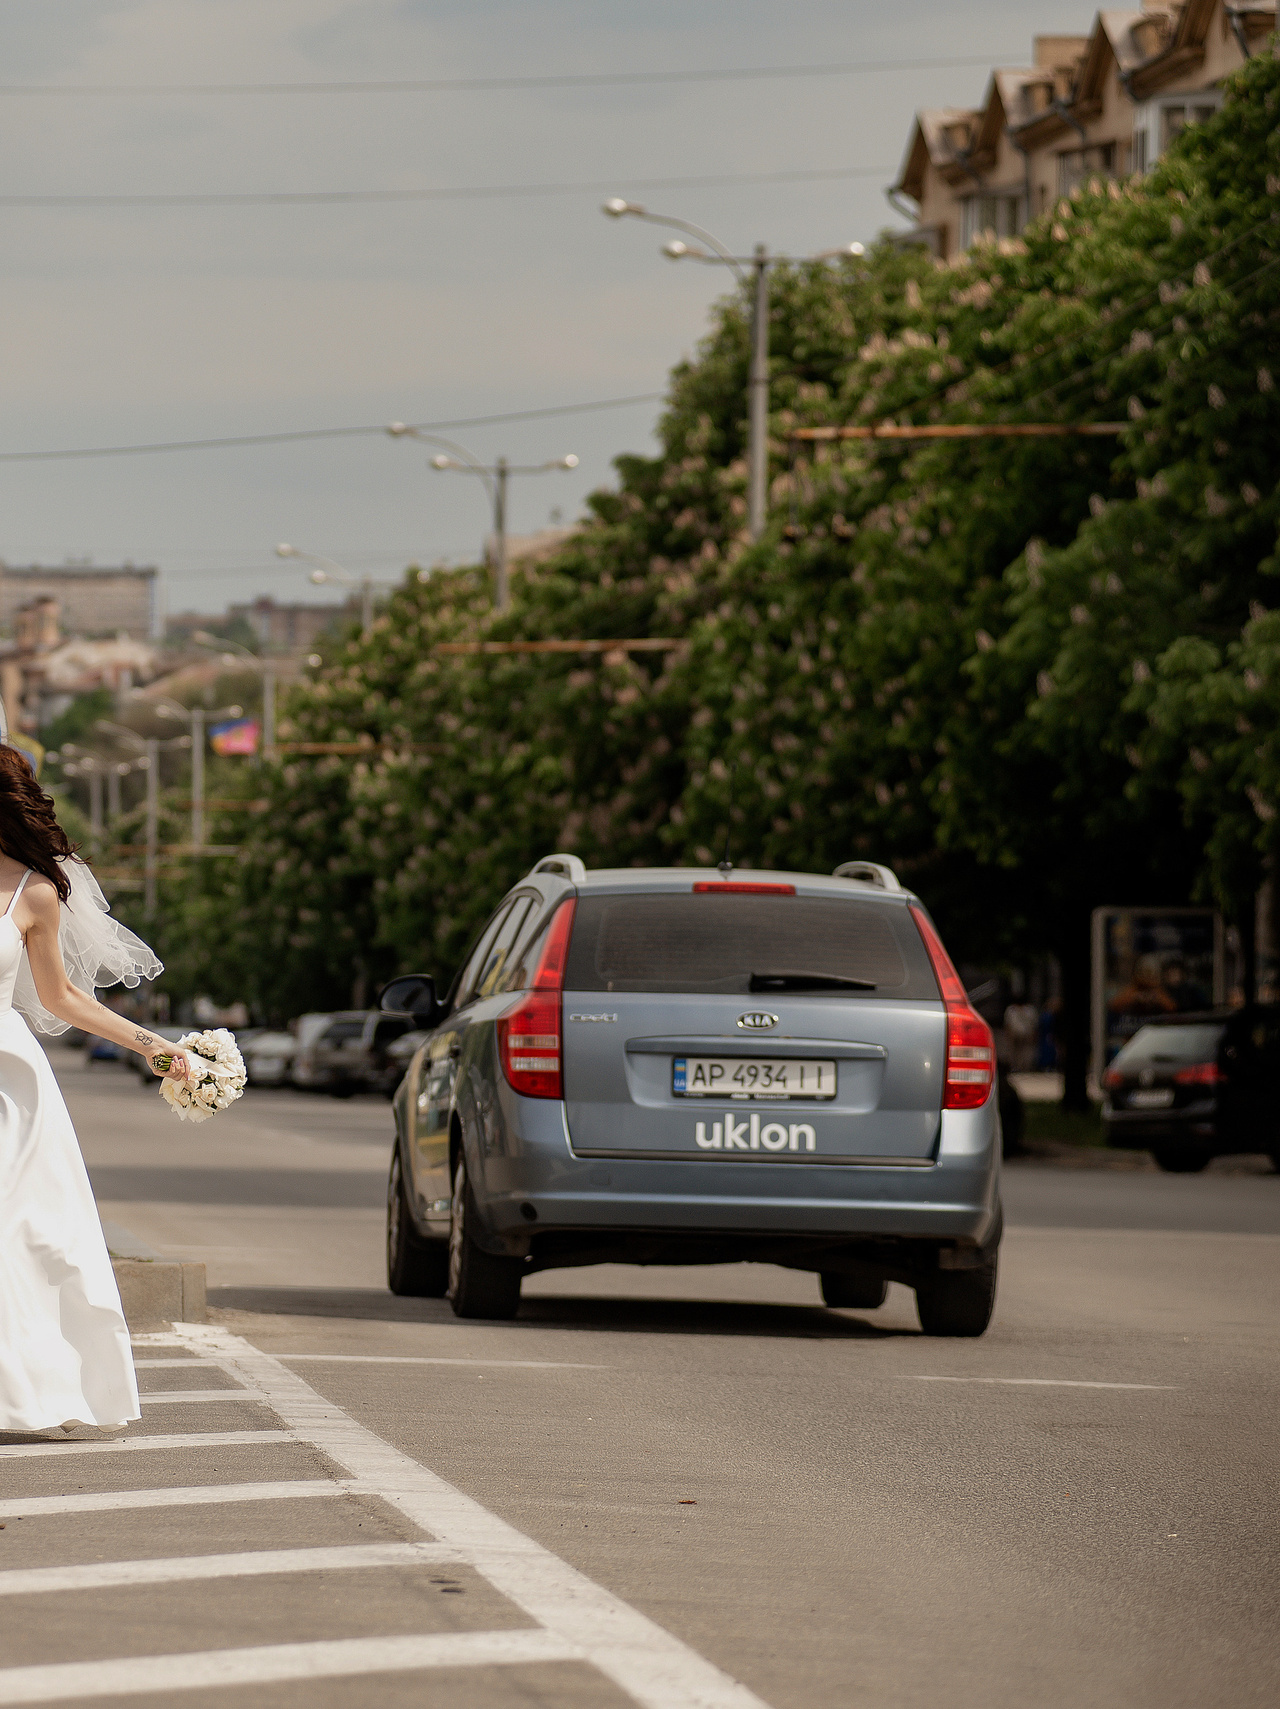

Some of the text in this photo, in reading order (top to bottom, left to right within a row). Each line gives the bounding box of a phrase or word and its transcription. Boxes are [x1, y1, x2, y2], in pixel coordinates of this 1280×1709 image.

[743, 1014, 773, 1027] KIA
[691, 1063, 725, 1087] AP
[732, 1064, 788, 1089] 4934
[695, 1112, 817, 1152] uklon
